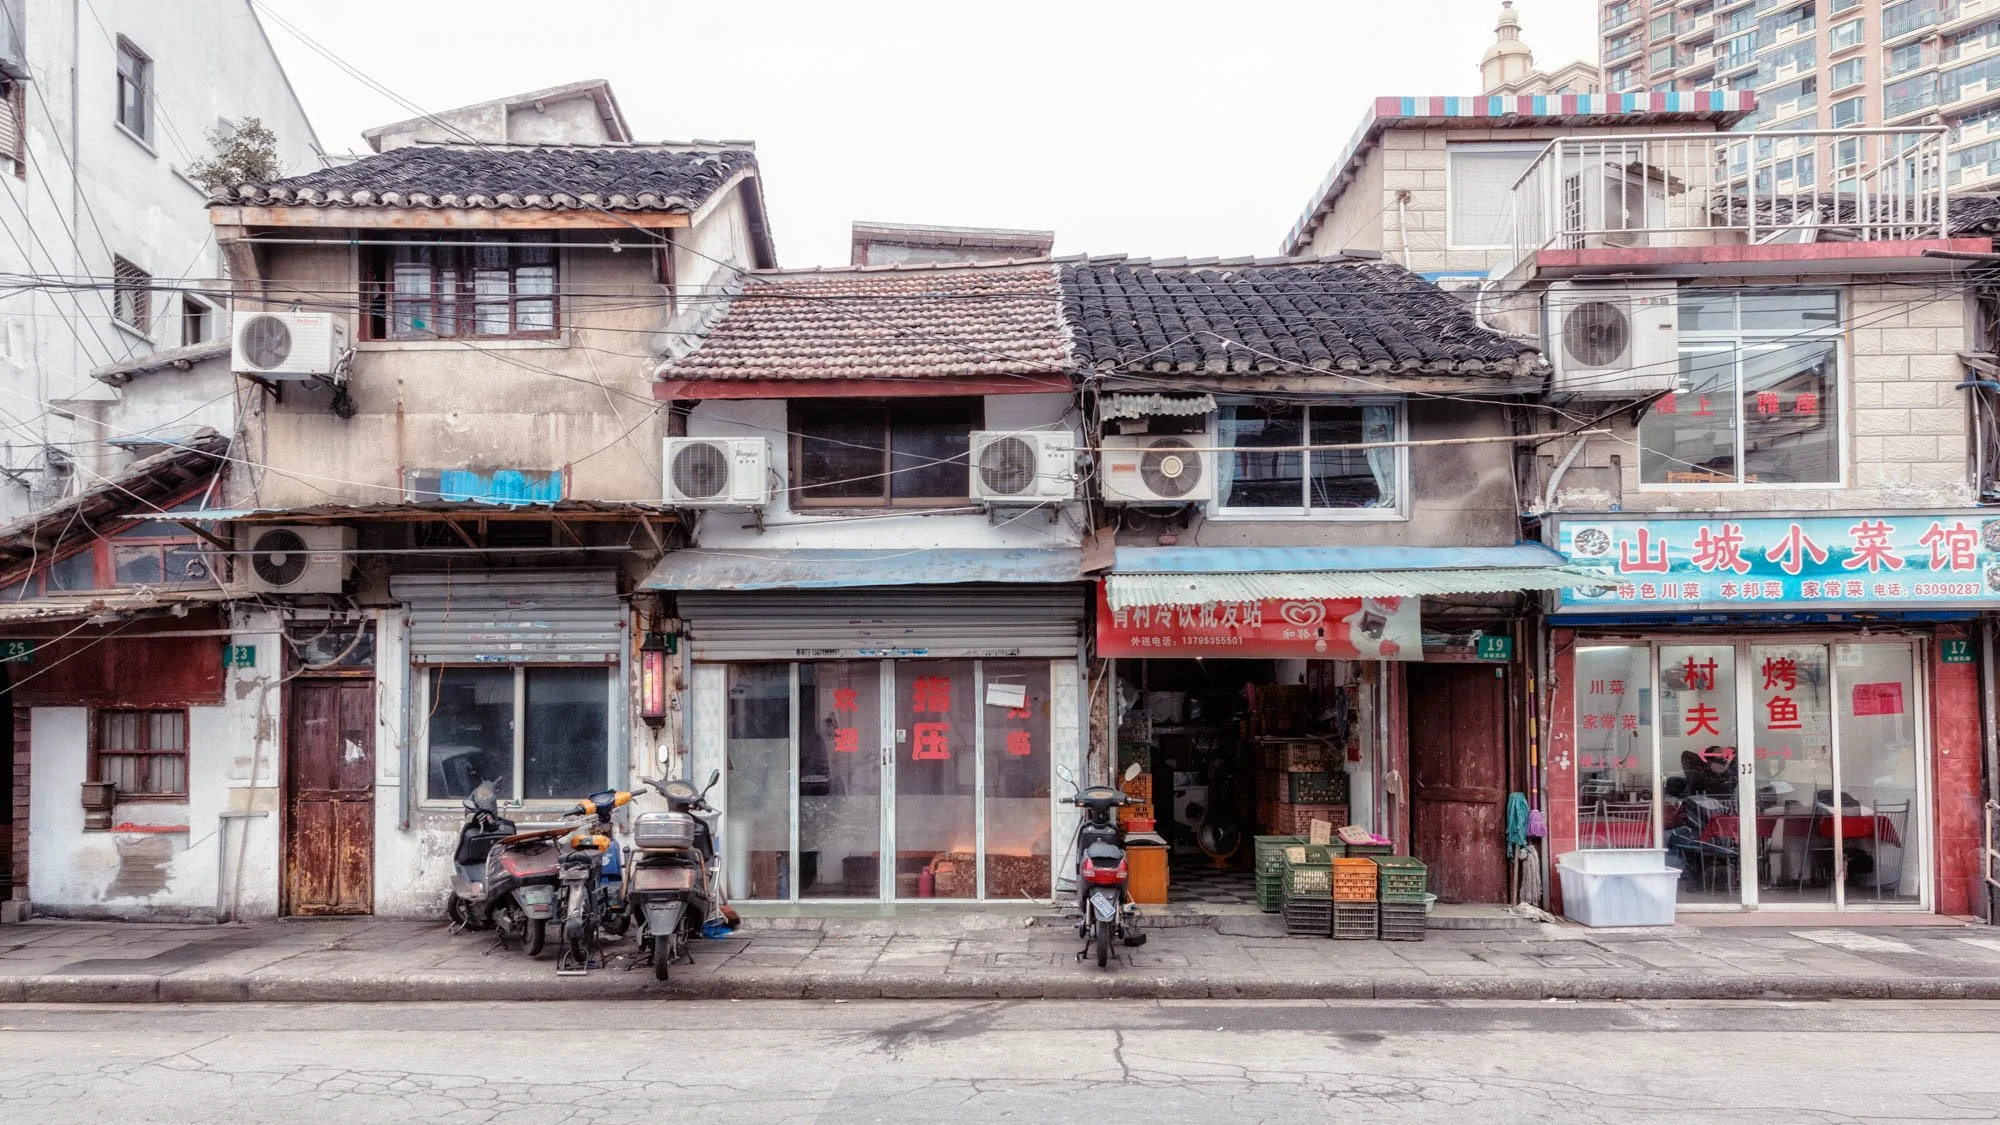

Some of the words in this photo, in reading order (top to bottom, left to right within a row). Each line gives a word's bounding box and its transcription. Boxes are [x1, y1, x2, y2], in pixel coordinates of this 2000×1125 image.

[1655, 392, 1716, 416] 楼上
[1756, 391, 1818, 415] 雅座
[1620, 520, 1979, 574] 山城小菜馆
[1618, 583, 1700, 600] 特色川菜
[1720, 581, 1783, 599] 本邦菜
[1802, 581, 1864, 597] 家常菜
[1914, 583, 1981, 596] 63090287
[1130, 636, 1177, 647] 外送电话：
[1181, 636, 1243, 646] 13795355501
[1282, 627, 1326, 641] 和路
[8, 642, 25, 655] 25
[1487, 638, 1504, 651] 19
[1951, 641, 1967, 654] 17
[234, 647, 248, 660] 23
[1590, 680, 1625, 695] 川菜
[1761, 656, 1803, 730] 烤鱼
[1683, 656, 1720, 736] 村夫
[833, 688, 859, 753] 欢迎
[912, 675, 951, 760] 指压
[1583, 714, 1638, 730] 家常菜
